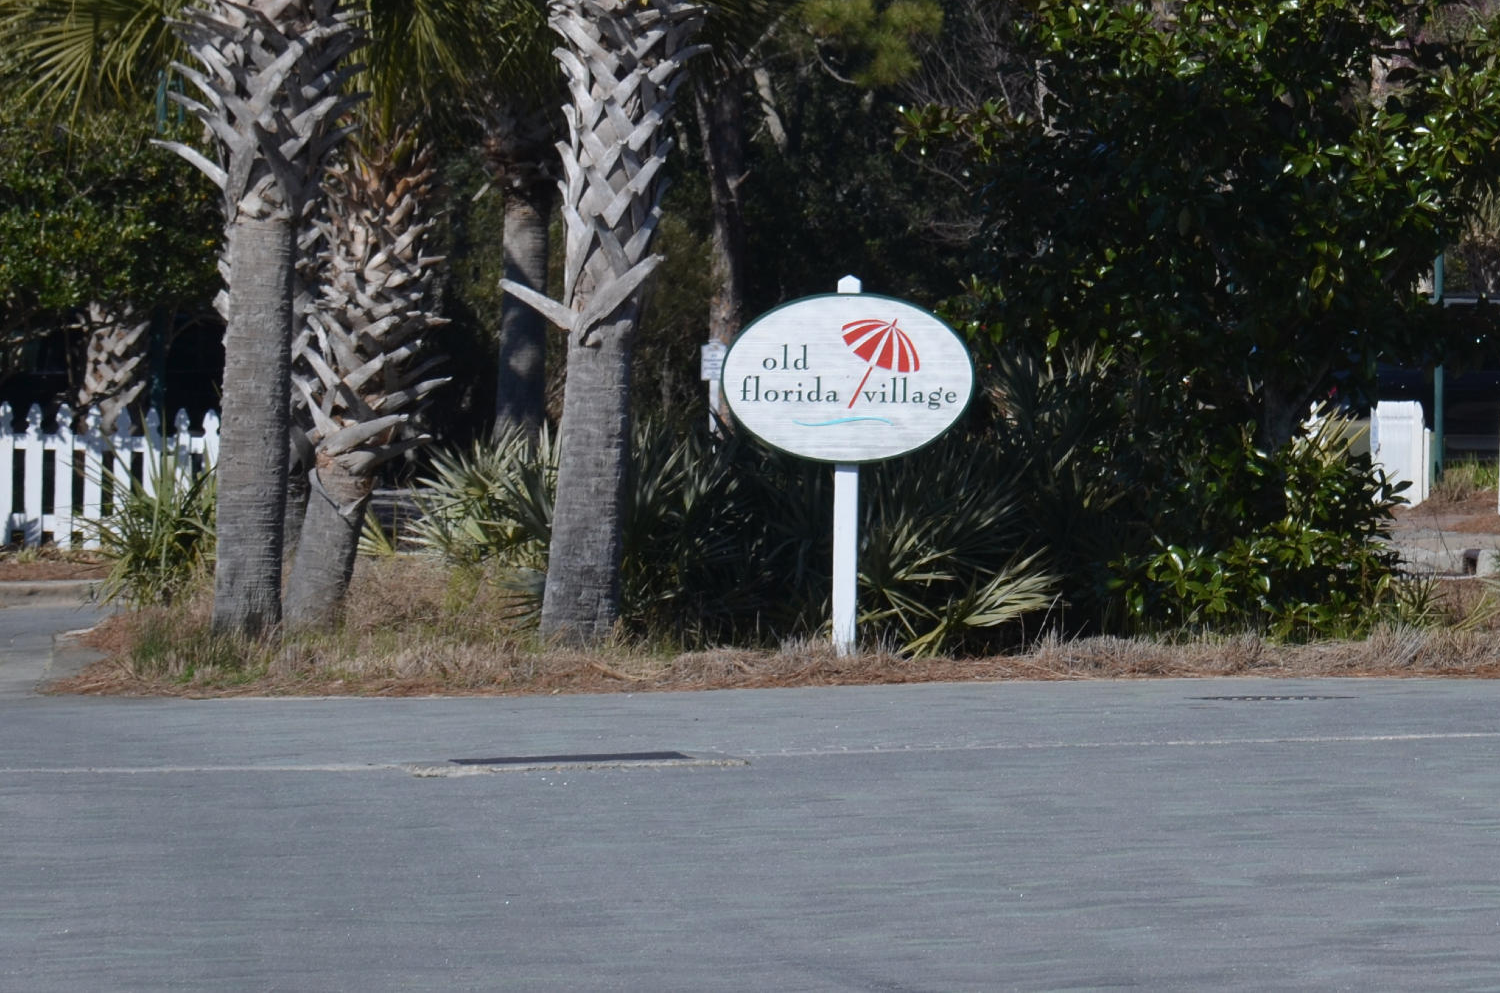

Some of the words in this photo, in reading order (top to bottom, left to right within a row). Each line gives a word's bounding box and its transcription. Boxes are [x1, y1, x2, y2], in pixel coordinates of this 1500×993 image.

[762, 343, 810, 371] old
[740, 375, 840, 403] florida
[863, 377, 958, 410] village
